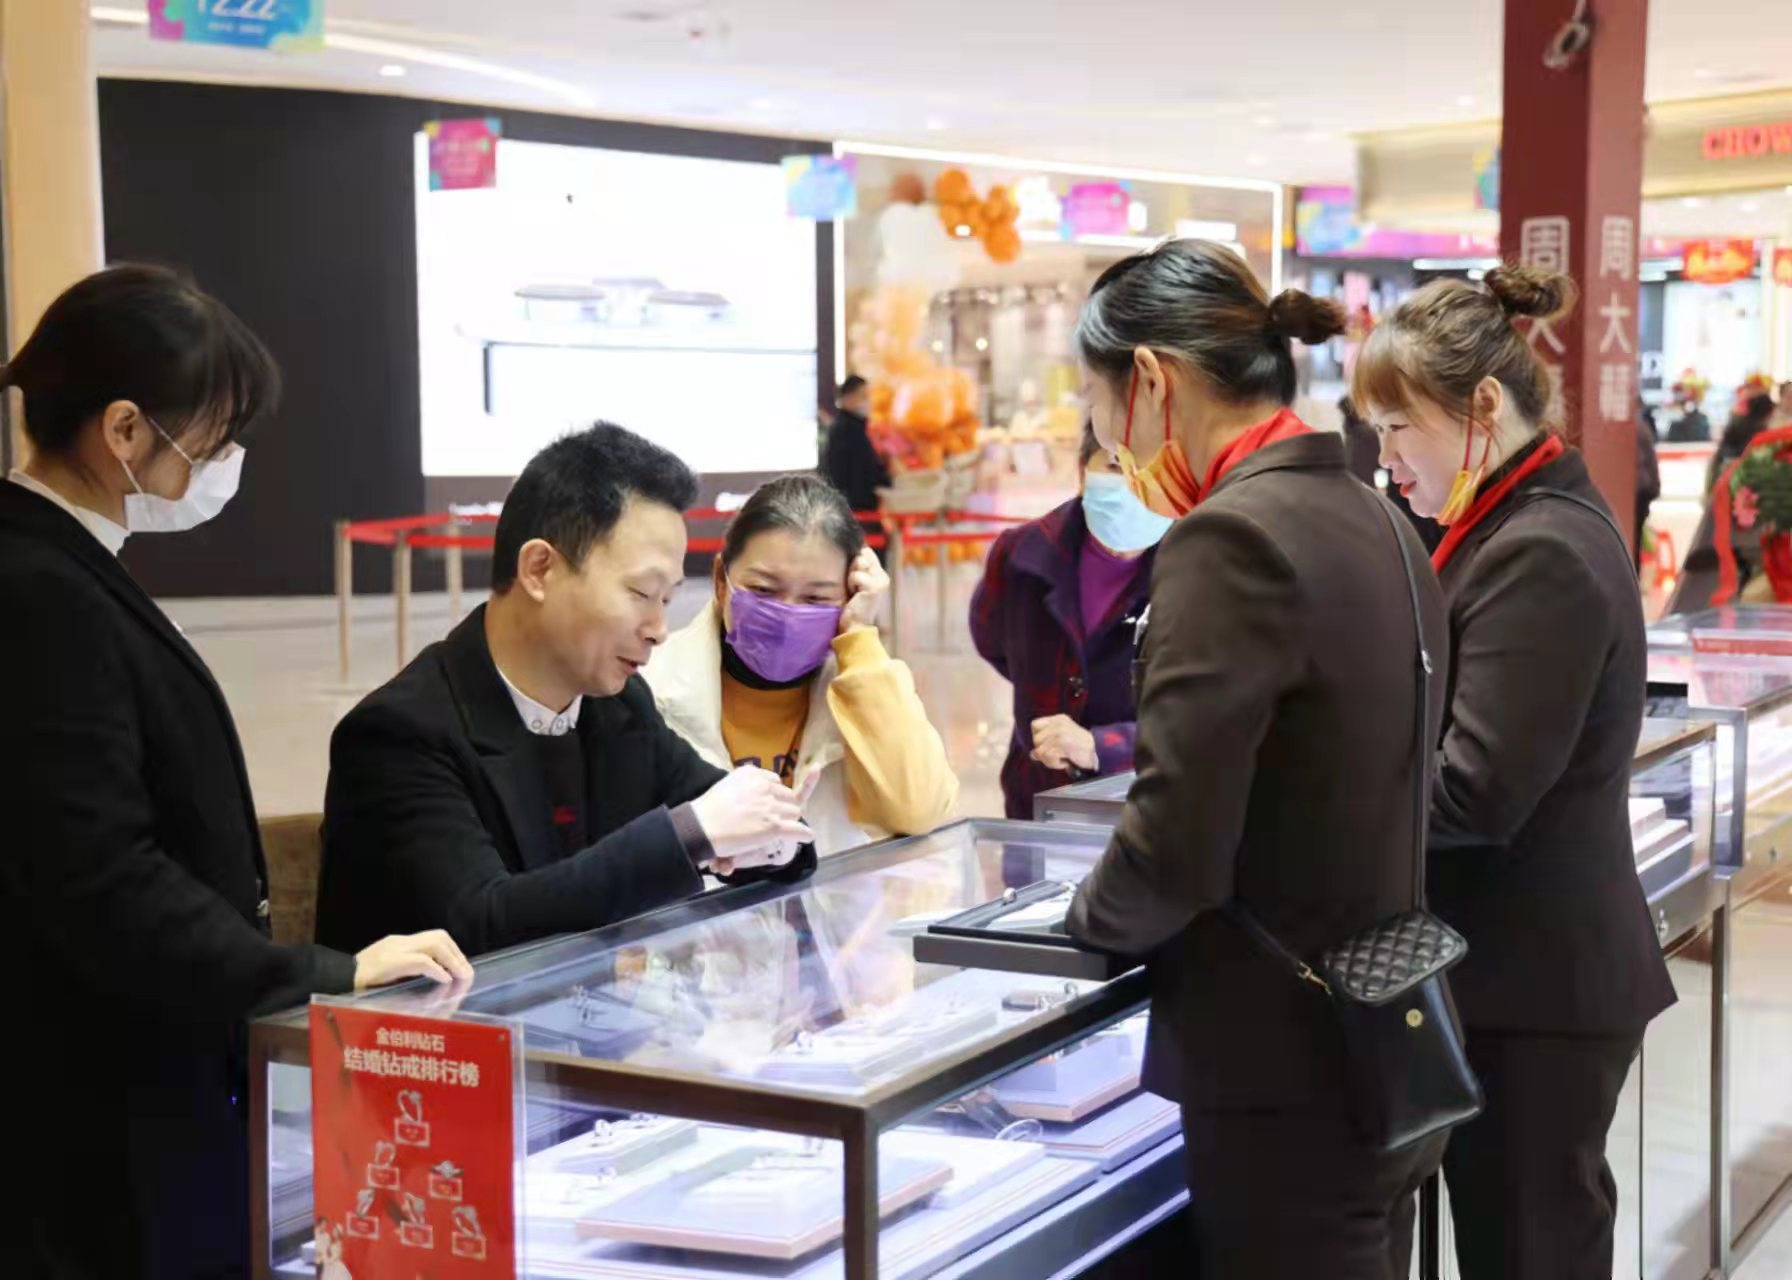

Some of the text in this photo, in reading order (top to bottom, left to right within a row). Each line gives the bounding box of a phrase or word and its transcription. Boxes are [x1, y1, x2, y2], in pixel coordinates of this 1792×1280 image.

[375, 1026, 445, 1053] 金伯利钻石
[343, 1044, 480, 1088] 结婚钻戒排行榜
